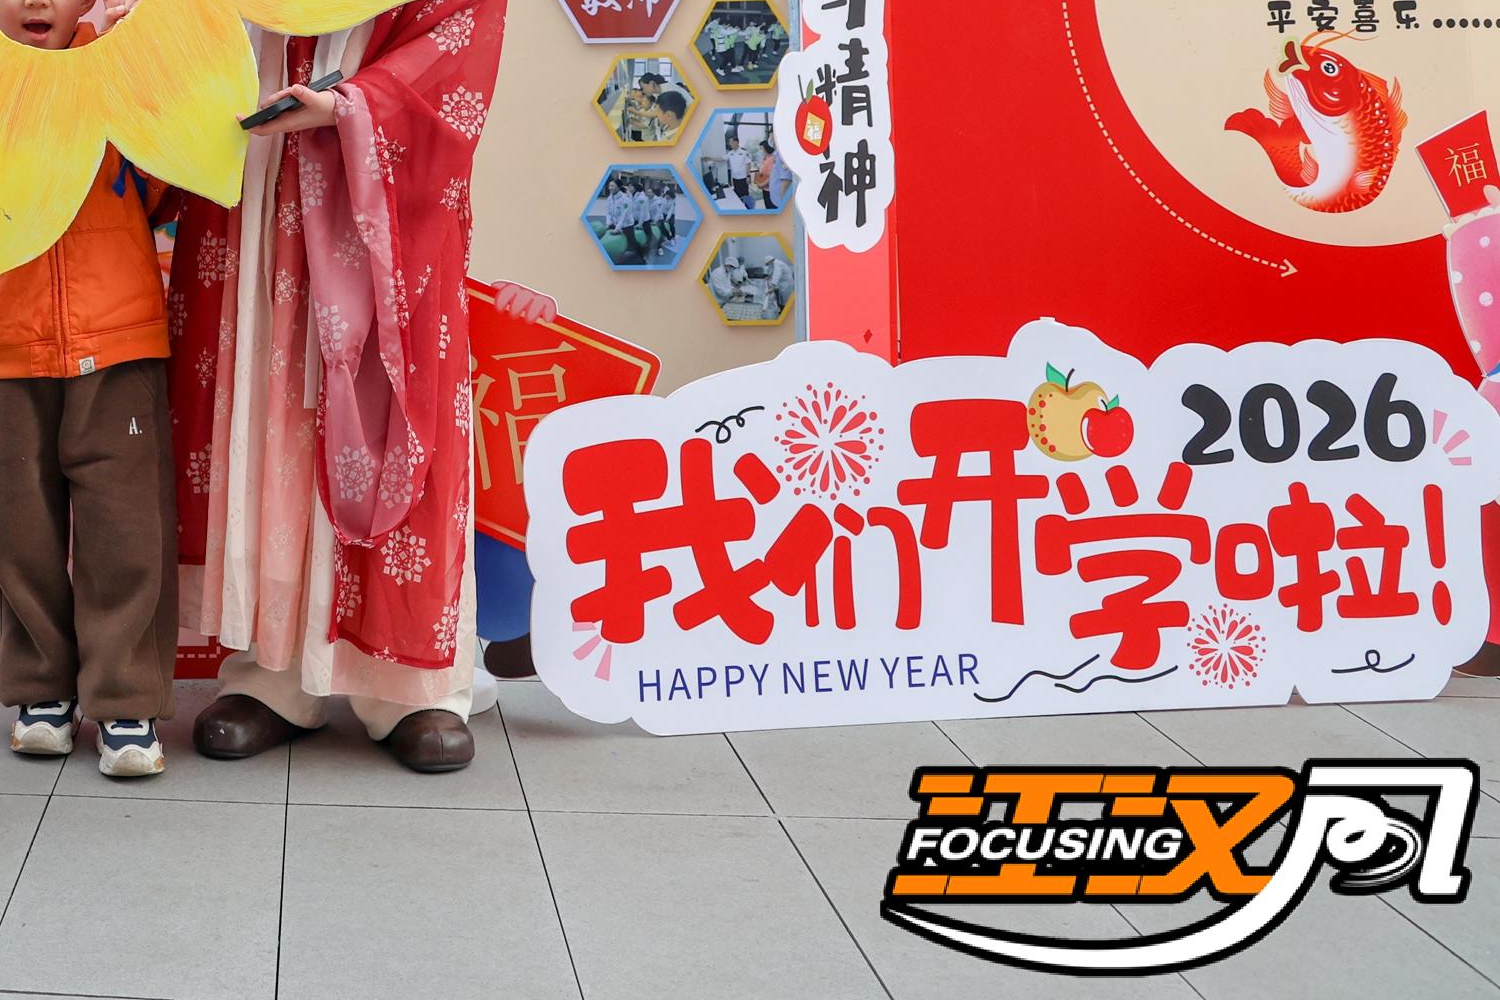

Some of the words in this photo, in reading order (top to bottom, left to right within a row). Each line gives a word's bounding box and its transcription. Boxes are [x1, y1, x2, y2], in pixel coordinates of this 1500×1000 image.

[1444, 141, 1489, 189] 福
[1181, 372, 1428, 466] 2026
[637, 660, 779, 703] HAPPY
[782, 658, 867, 695] NEW
[867, 652, 981, 690] YEAR
